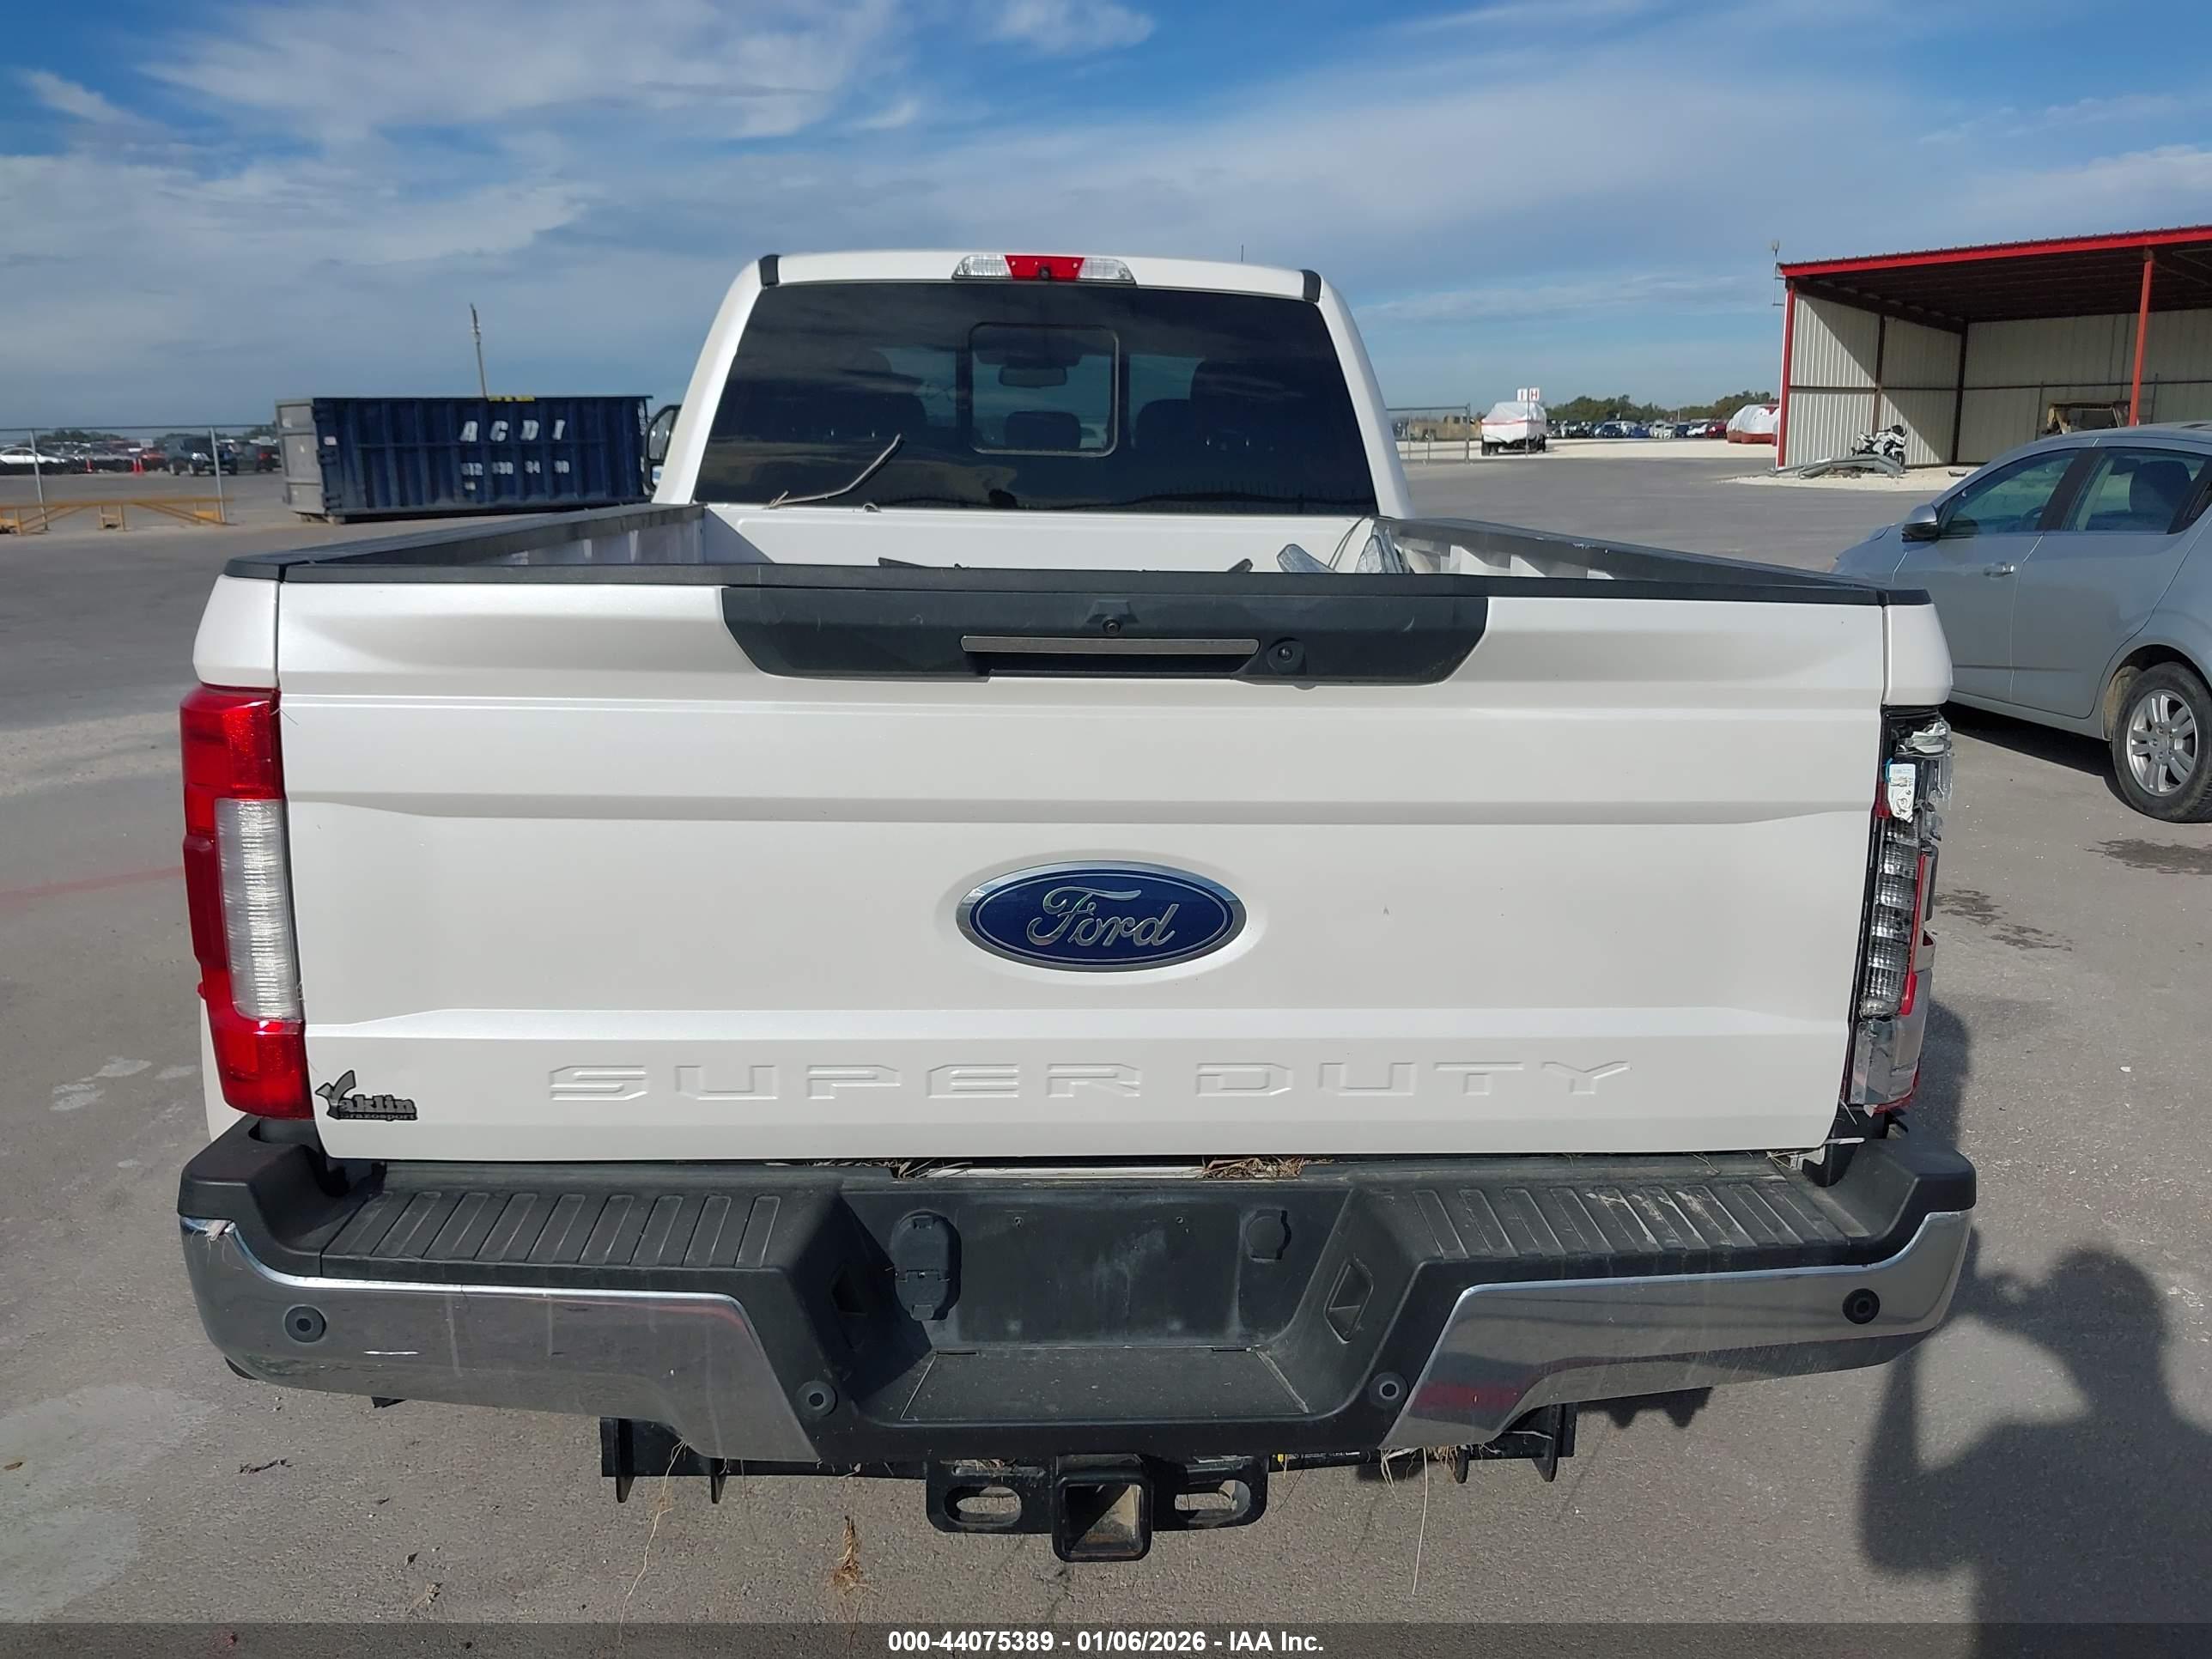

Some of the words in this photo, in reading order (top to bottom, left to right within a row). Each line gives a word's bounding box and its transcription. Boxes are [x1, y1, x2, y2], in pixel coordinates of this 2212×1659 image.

[1026, 885, 1181, 946] Ford
[549, 1064, 1142, 1101] SUPER
[1194, 1060, 1632, 1098] DUTY
